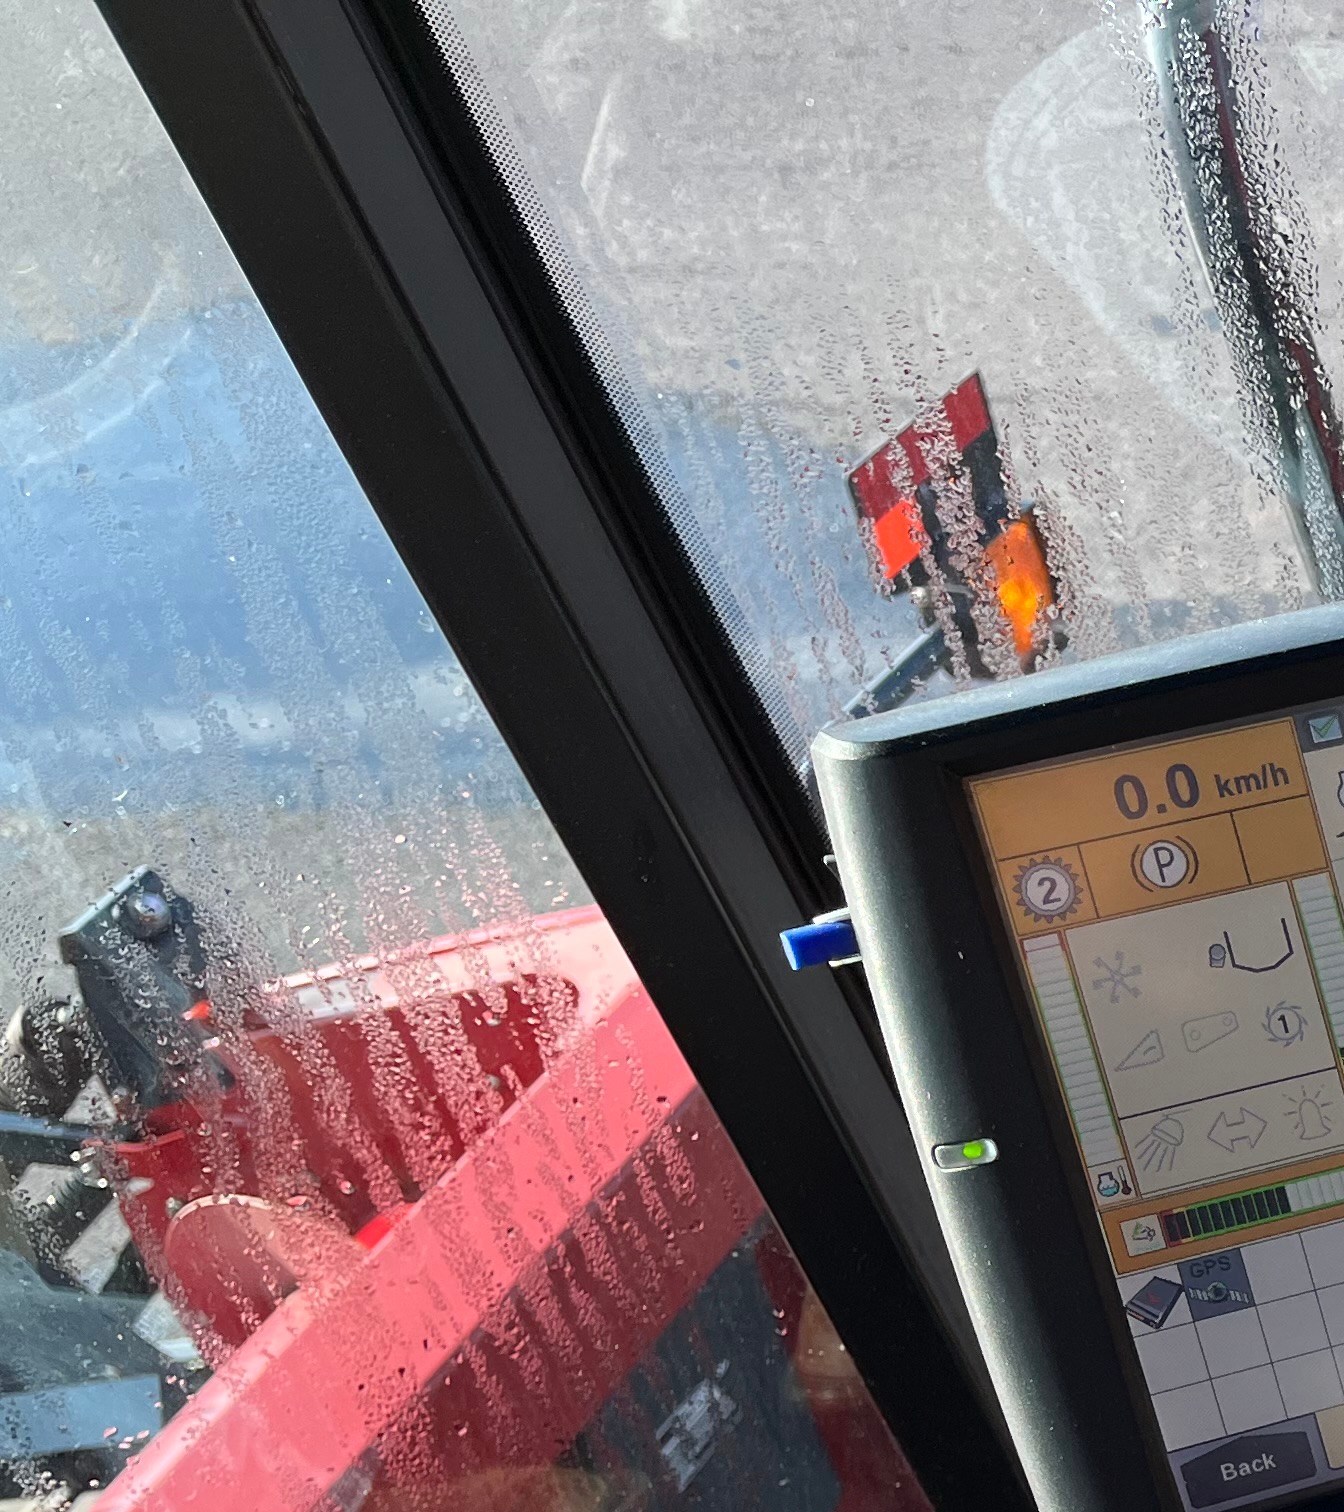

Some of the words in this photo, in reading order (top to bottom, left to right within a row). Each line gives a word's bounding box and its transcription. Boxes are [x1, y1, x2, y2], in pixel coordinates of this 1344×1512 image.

[1113, 761, 1201, 821] 0.0
[1213, 763, 1291, 800] km/h
[1153, 846, 1176, 883] P
[1035, 875, 1062, 906] 2
[1276, 1014, 1292, 1035] 1
[1189, 1254, 1232, 1280] GPS
[1220, 1451, 1278, 1482] Back
